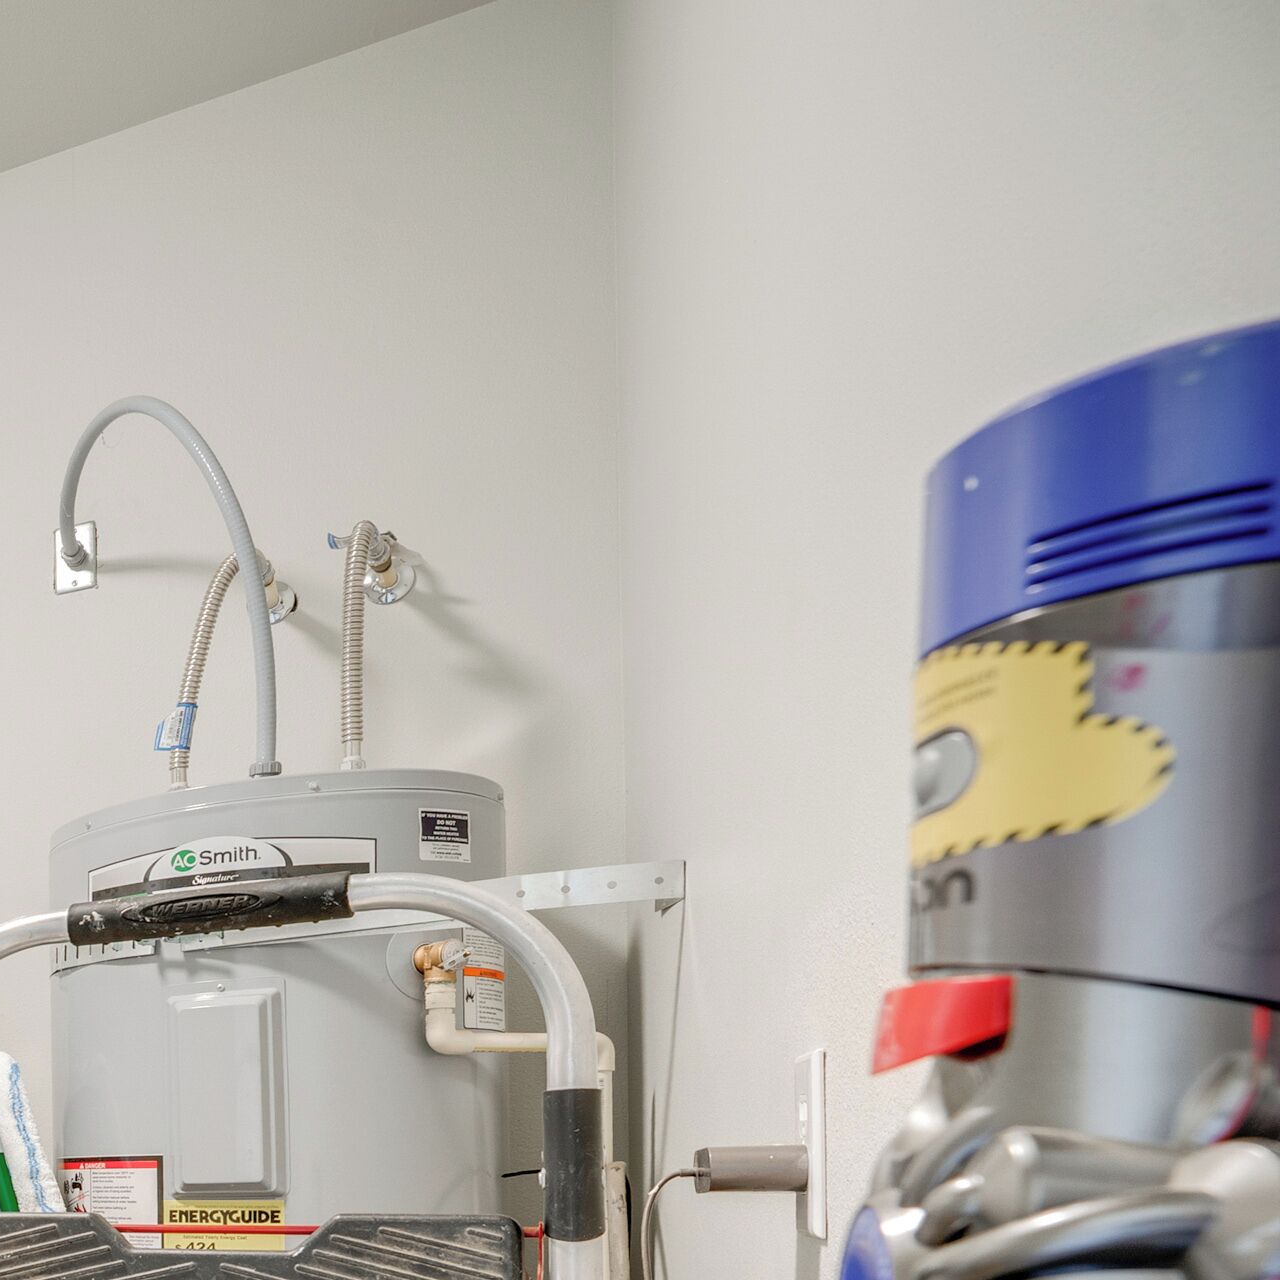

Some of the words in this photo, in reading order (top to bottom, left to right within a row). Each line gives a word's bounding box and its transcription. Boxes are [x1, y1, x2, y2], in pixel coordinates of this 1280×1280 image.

[199, 846, 258, 866] Smith
[192, 873, 236, 885] Signature
[151, 895, 249, 918] WERNER
[169, 1209, 281, 1225] ENERGYGUIDE
